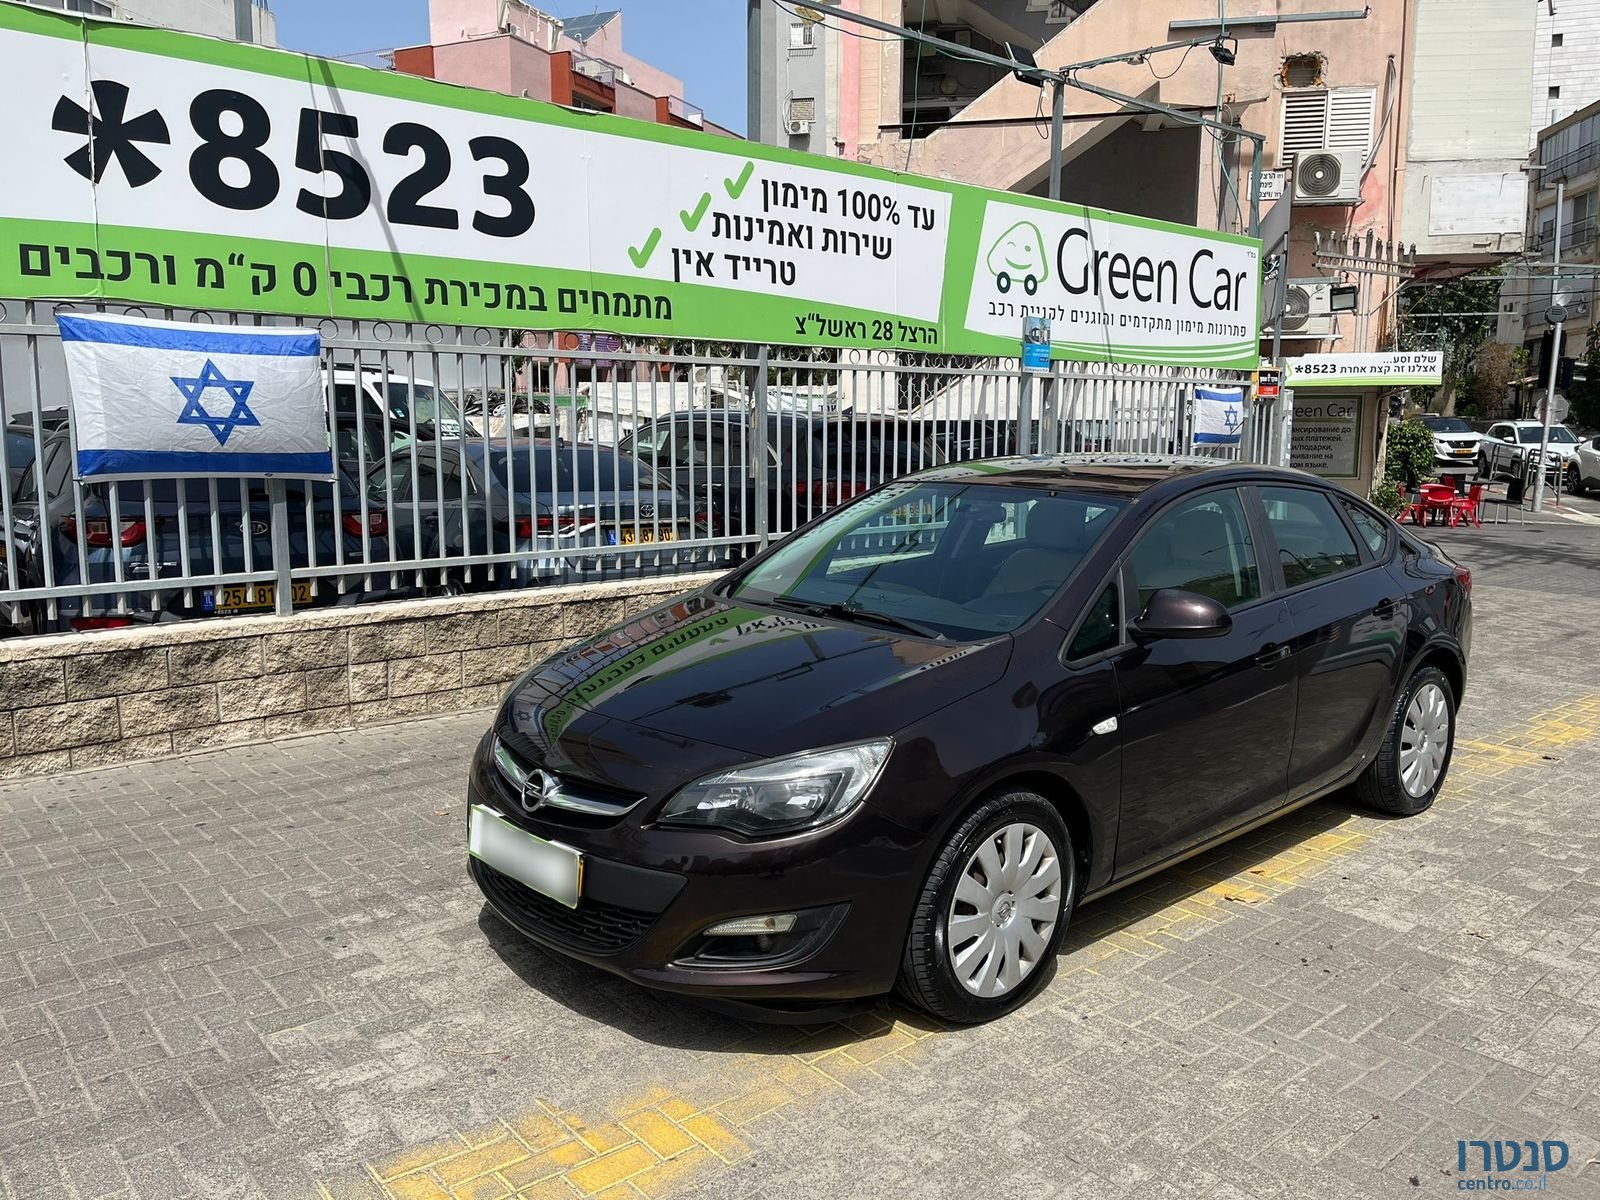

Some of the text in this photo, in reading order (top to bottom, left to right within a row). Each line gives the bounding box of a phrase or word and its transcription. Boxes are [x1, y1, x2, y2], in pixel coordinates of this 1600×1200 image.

[761, 178, 935, 231] עד 100% מימון
[711, 211, 893, 260] שירות ואמינות
[672, 247, 796, 286] טרייד אין
[1057, 227, 1247, 312] Green Car
[19, 243, 673, 321] מתמחים במכירת רכבי 0 ק"מ ורכבים
[794, 312, 938, 345] הרצל 28 ראשל"צ
[988, 301, 1247, 338] פתרונות מימון מתקדמים והוגנים לקניית רכב
[1339, 365, 1366, 374] אחרת
[1369, 365, 1391, 375] קצת
[1393, 364, 1404, 373] זה
[1407, 364, 1437, 373] אצלנו
[1413, 355, 1437, 363] שלם
[1293, 403, 1353, 418] reen Car
[1340, 426, 1352, 434] до
